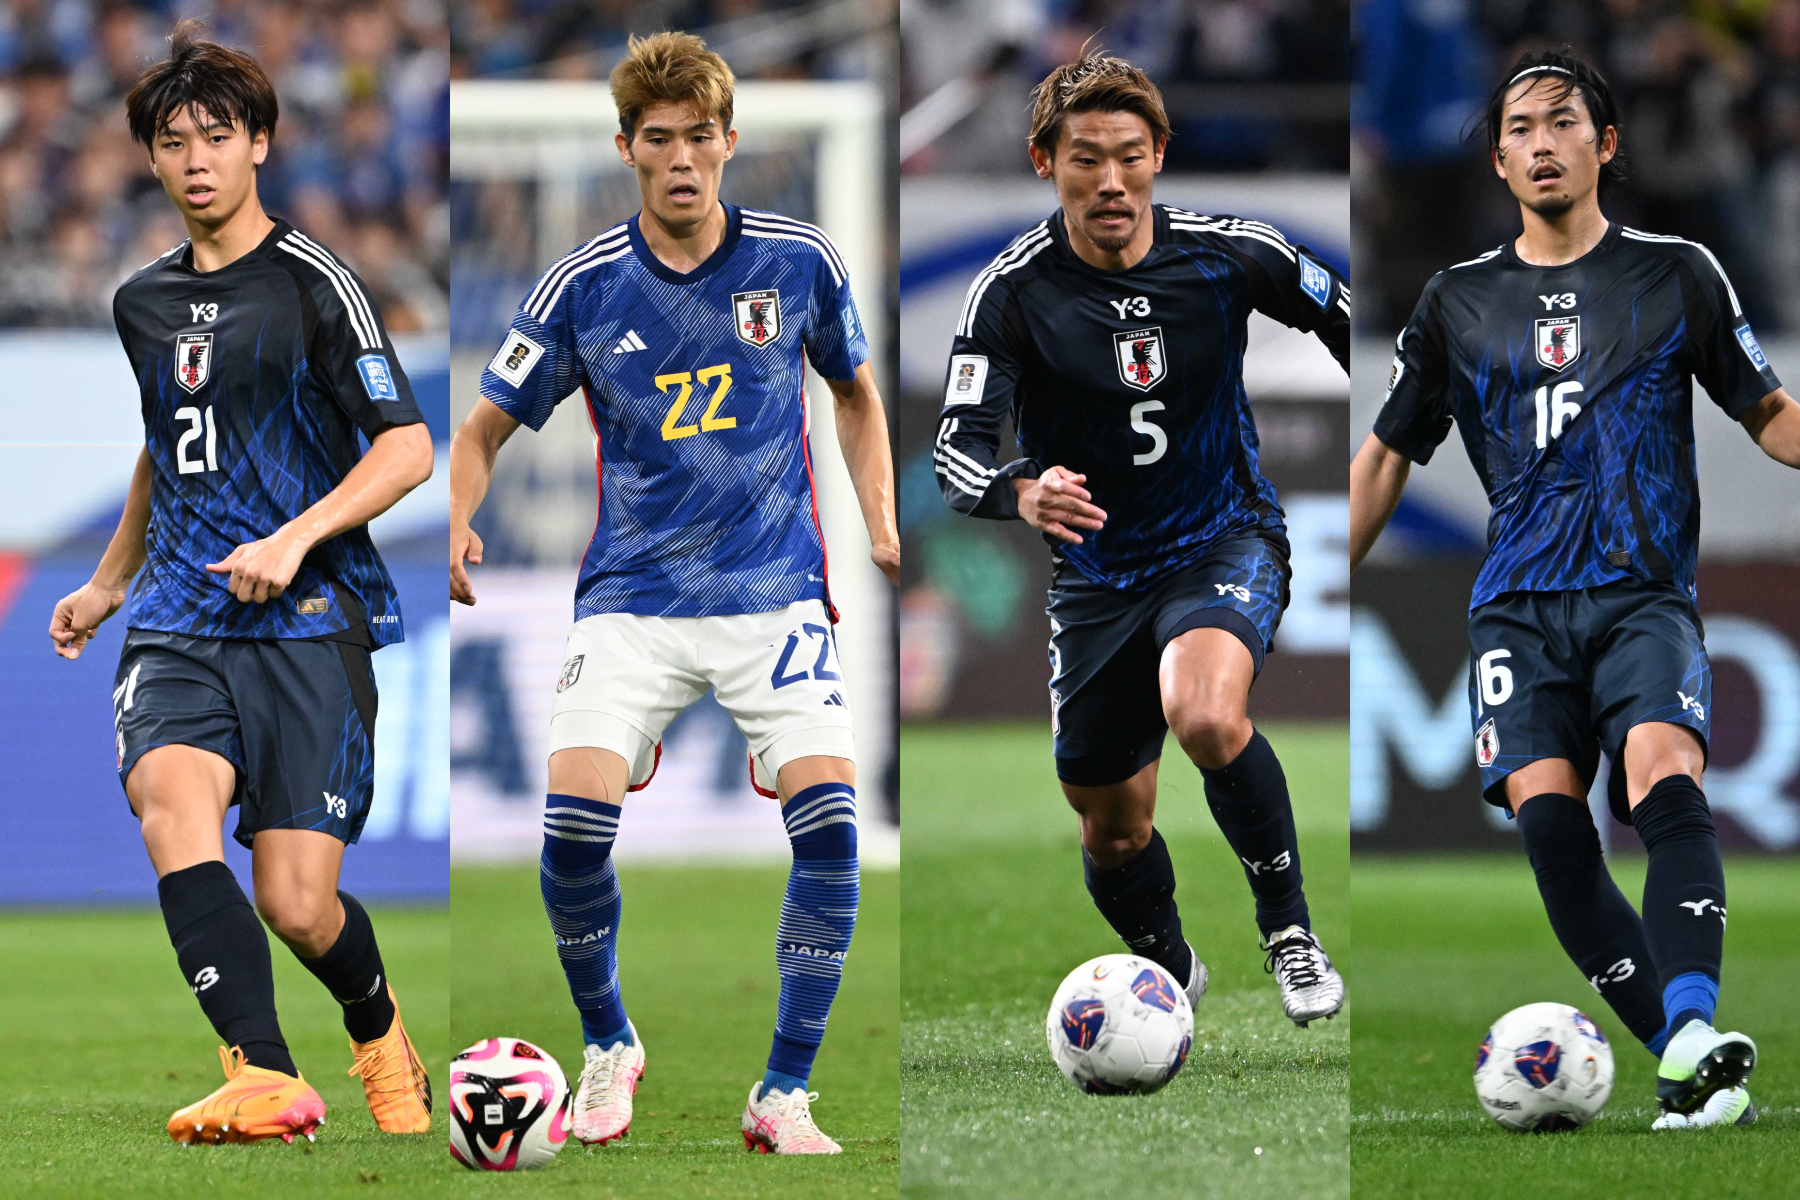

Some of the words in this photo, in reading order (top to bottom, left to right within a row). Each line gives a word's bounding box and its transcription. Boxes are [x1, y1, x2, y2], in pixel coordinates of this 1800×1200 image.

[189, 303, 219, 323] Y-3
[1109, 296, 1151, 320] Y-3
[1539, 292, 1577, 311] Y-3
[750, 328, 770, 339] JFA
[1125, 330, 1151, 340] JAPAN
[1549, 351, 1569, 362] JFA
[185, 373, 200, 383] JFA
[1133, 369, 1155, 382] JFA
[654, 363, 737, 441] 22
[1534, 380, 1584, 450] 16
[174, 404, 219, 474] 21
[1130, 400, 1168, 466] 5
[1213, 583, 1251, 603] Y-3
[768, 622, 842, 691] 22
[1476, 648, 1514, 719] 16
[1676, 690, 1705, 721] Y-3
[322, 791, 347, 819] Y-3
[1241, 850, 1291, 876] Y-3
[555, 926, 610, 945] APAN
[190, 966, 220, 994] -3
